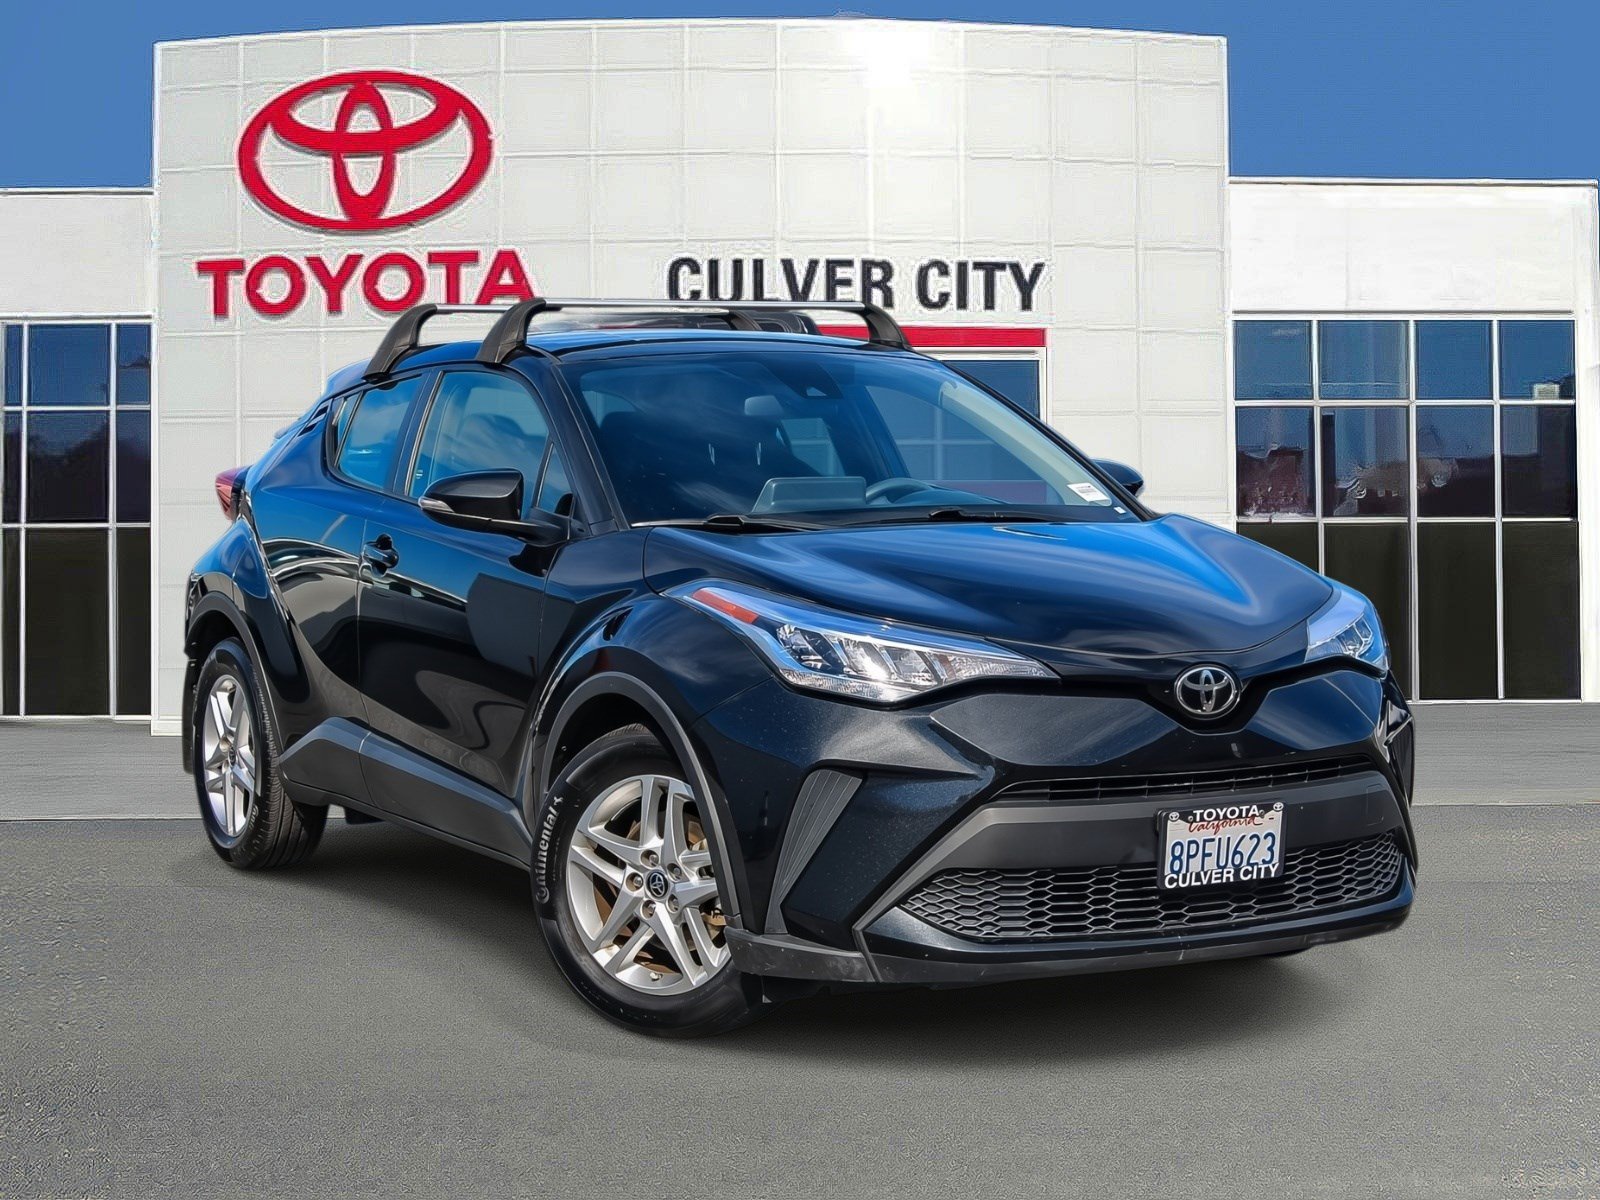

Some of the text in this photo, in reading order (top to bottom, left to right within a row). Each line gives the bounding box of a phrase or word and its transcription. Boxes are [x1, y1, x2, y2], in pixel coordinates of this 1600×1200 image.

[197, 249, 537, 317] TOYOTA
[668, 257, 1045, 311] CULVER CITY
[1193, 805, 1260, 822] TOYOTA
[1169, 831, 1276, 875] 8PFU623
[1164, 862, 1280, 889] CULVER CITY
